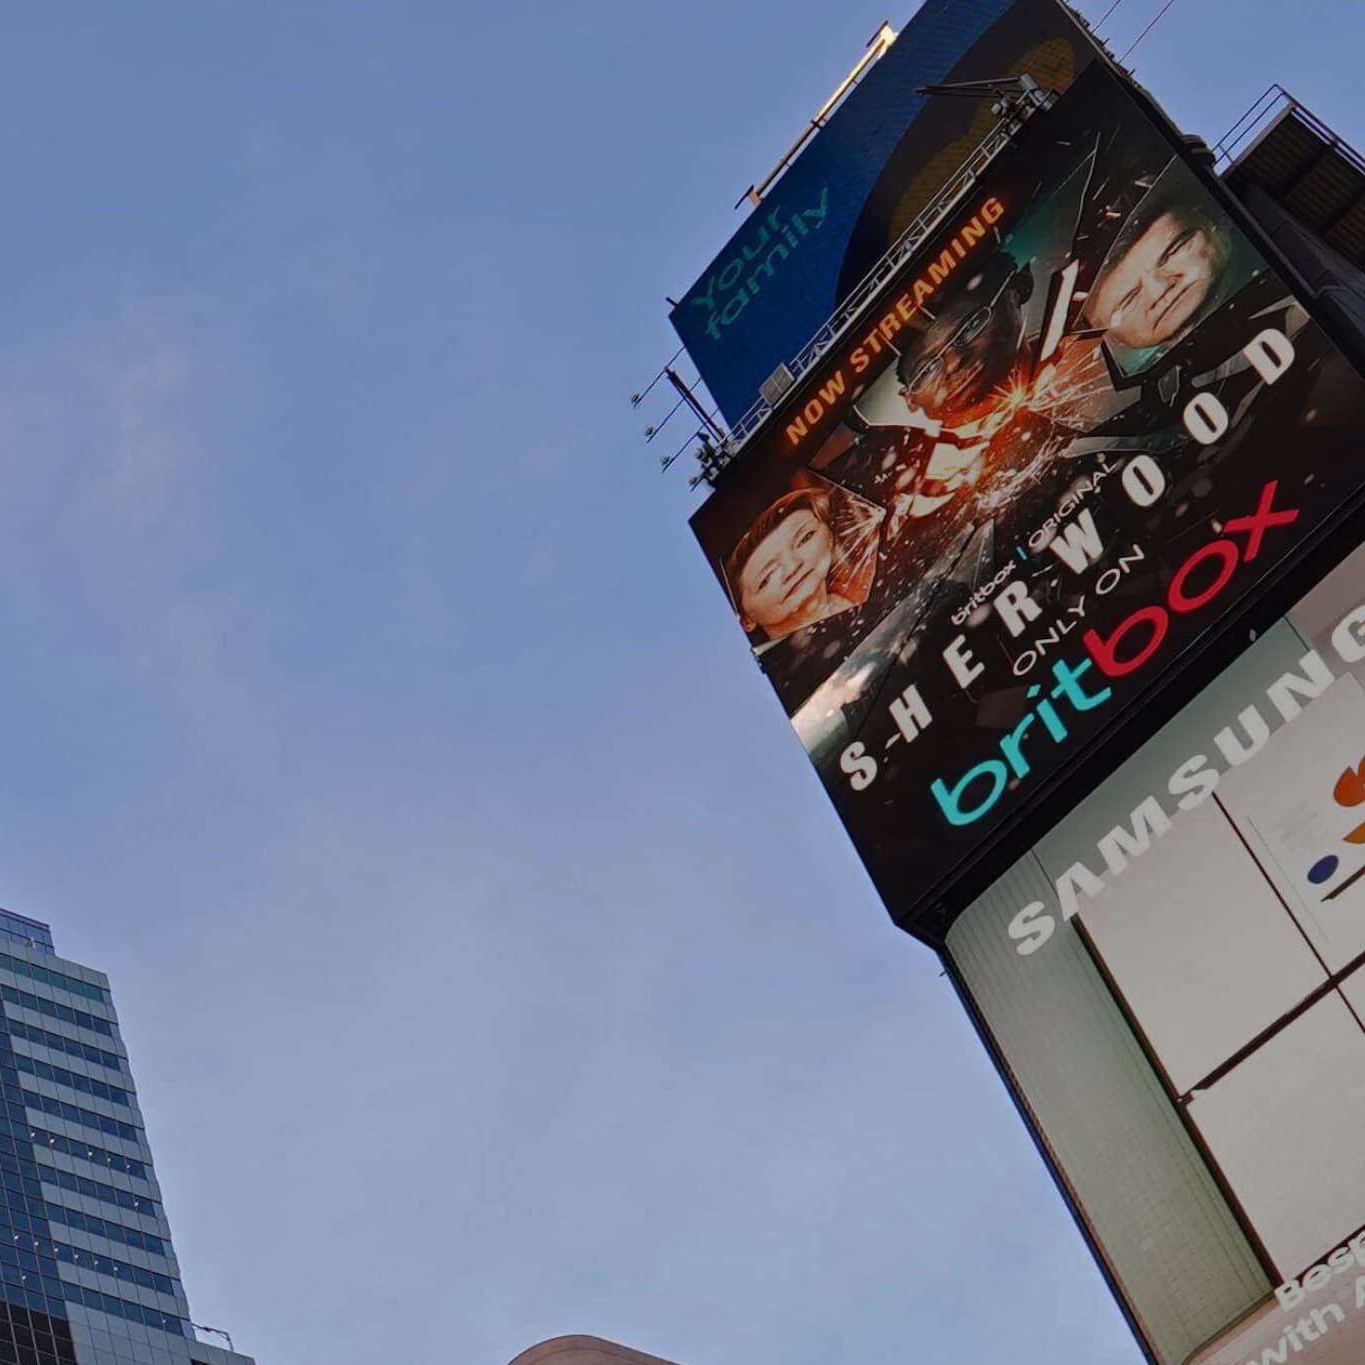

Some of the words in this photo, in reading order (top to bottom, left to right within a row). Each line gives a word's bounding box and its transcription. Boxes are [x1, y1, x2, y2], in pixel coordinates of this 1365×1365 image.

[706, 187, 829, 341] family
[784, 373, 846, 447] NOW
[849, 197, 1006, 373] STREAMING
[951, 560, 1018, 625] britbox
[1029, 462, 1118, 549] ORIGINAL
[1012, 594, 1086, 677] ONLY
[1095, 543, 1145, 596] ON
[931, 479, 1300, 827] britbox
